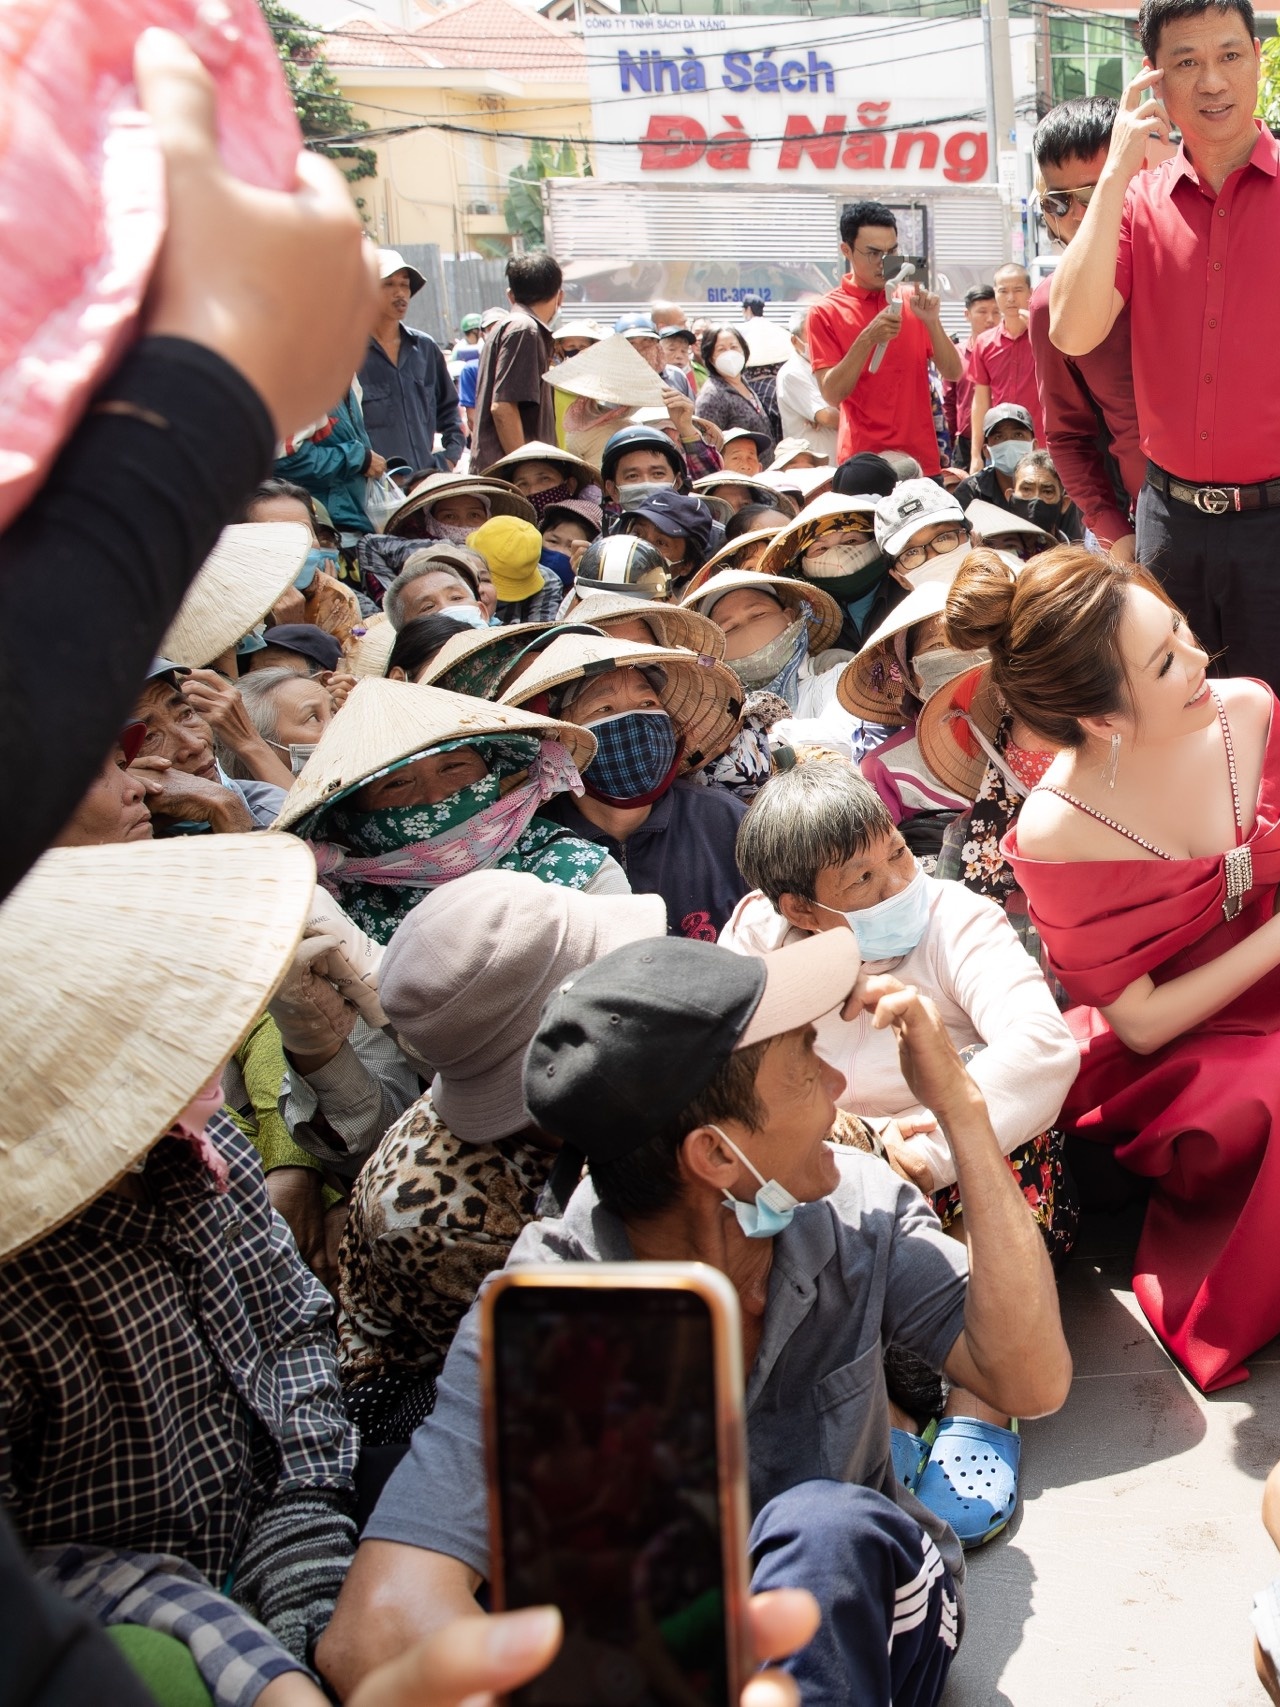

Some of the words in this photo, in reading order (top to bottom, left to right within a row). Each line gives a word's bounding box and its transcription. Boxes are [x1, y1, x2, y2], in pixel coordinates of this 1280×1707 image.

[615, 19, 625, 28] TY
[630, 19, 654, 28] TNHH
[618, 47, 706, 93] Nhà
[722, 47, 835, 93] Sách
[637, 114, 752, 170] Đà
[777, 101, 989, 183] Nẵng
